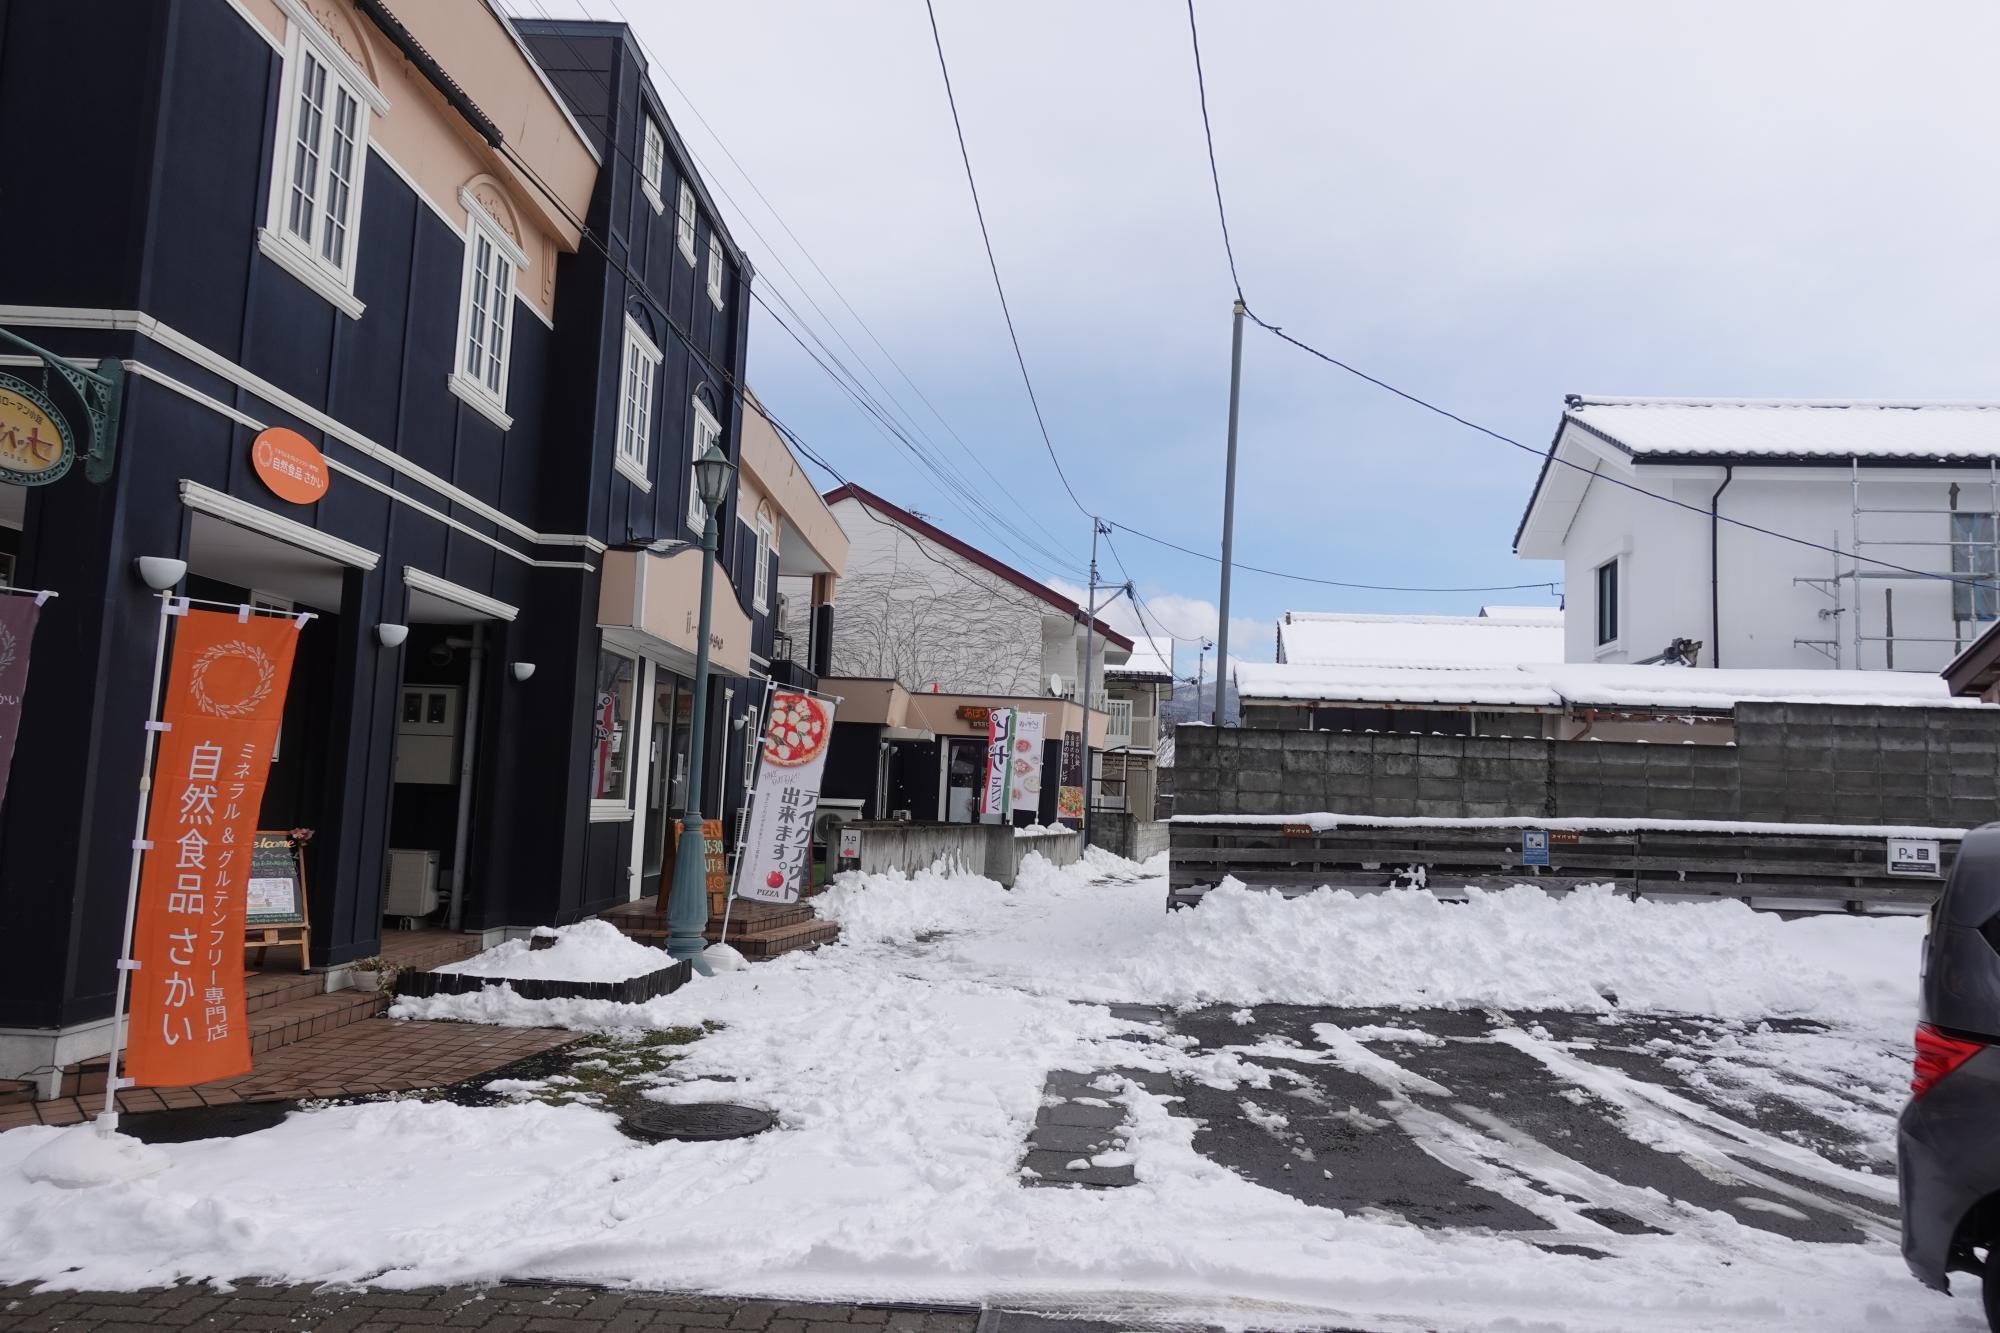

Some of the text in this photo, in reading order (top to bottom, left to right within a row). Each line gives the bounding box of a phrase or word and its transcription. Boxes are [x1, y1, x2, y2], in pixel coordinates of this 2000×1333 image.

[273, 456, 302, 481] 自然食品
[163, 740, 222, 1046] 自然食品 さかい
[203, 743, 256, 1042] ミネラル&グルテンフリー専門店
[756, 887, 781, 899] PIZZA
[787, 789, 818, 900] テイクアウト
